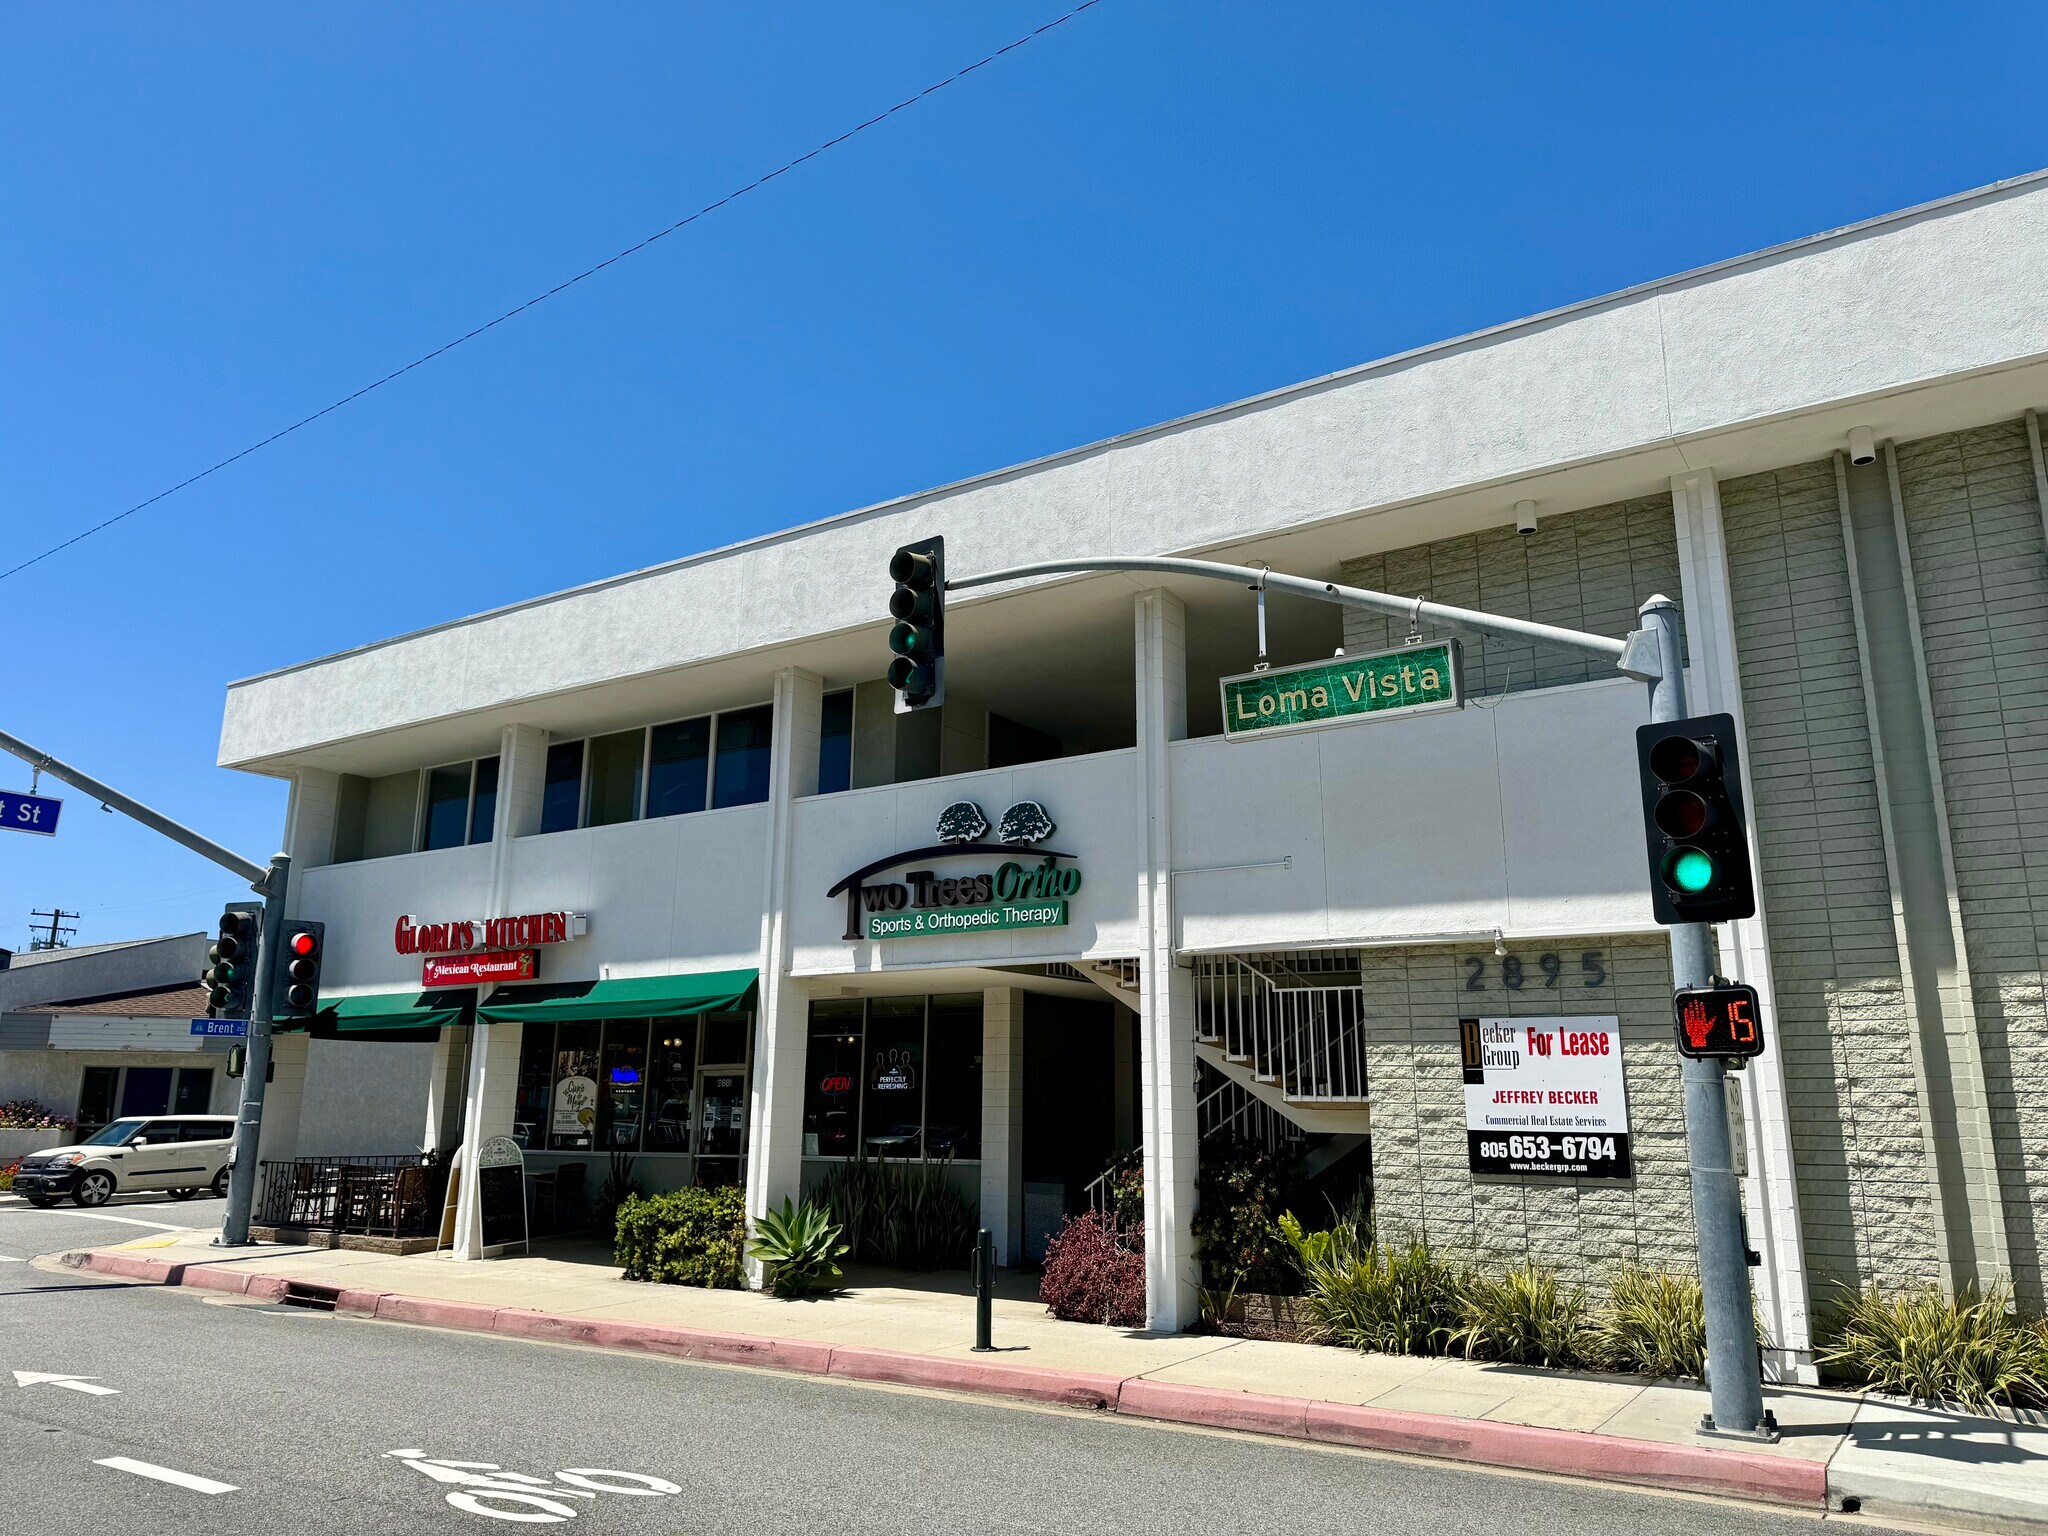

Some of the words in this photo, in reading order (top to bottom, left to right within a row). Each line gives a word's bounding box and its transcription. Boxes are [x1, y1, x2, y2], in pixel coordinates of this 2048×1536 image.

[1236, 686, 1329, 720] Loma
[1341, 664, 1441, 702] Vista
[17, 803, 41, 824] St
[485, 911, 567, 949] KITCHEN
[871, 915, 912, 936] Sports
[915, 915, 925, 930] &
[928, 909, 1000, 930] Orthopedic
[1002, 906, 1060, 925] Therapy
[433, 963, 469, 978] Mexican
[470, 960, 518, 977] Restaurant
[1464, 952, 1606, 991] 2895
[207, 1021, 235, 1034] Brent
[1727, 1000, 1755, 1042] 15
[1527, 1026, 1553, 1057] For
[1559, 1026, 1610, 1056] Lease
[1482, 1044, 1520, 1069] Group
[821, 1077, 851, 1091] OPEN
[877, 1082, 908, 1090] REFRESHING
[879, 1075, 907, 1083] PERFECTLY
[1492, 1090, 1544, 1105] JEFFREY
[1549, 1091, 1599, 1105] BECKER
[1730, 1087, 1740, 1106] NO
[1485, 1114, 1529, 1126] Commercial
[1531, 1115, 1548, 1125] Real
[1550, 1115, 1573, 1126] Estate
[1575, 1115, 1607, 1127] Services
[1480, 1142, 1508, 1158] 805
[1509, 1135, 1617, 1161] 653-6794
[1509, 1161, 1588, 1173] www.beckergrp.com
